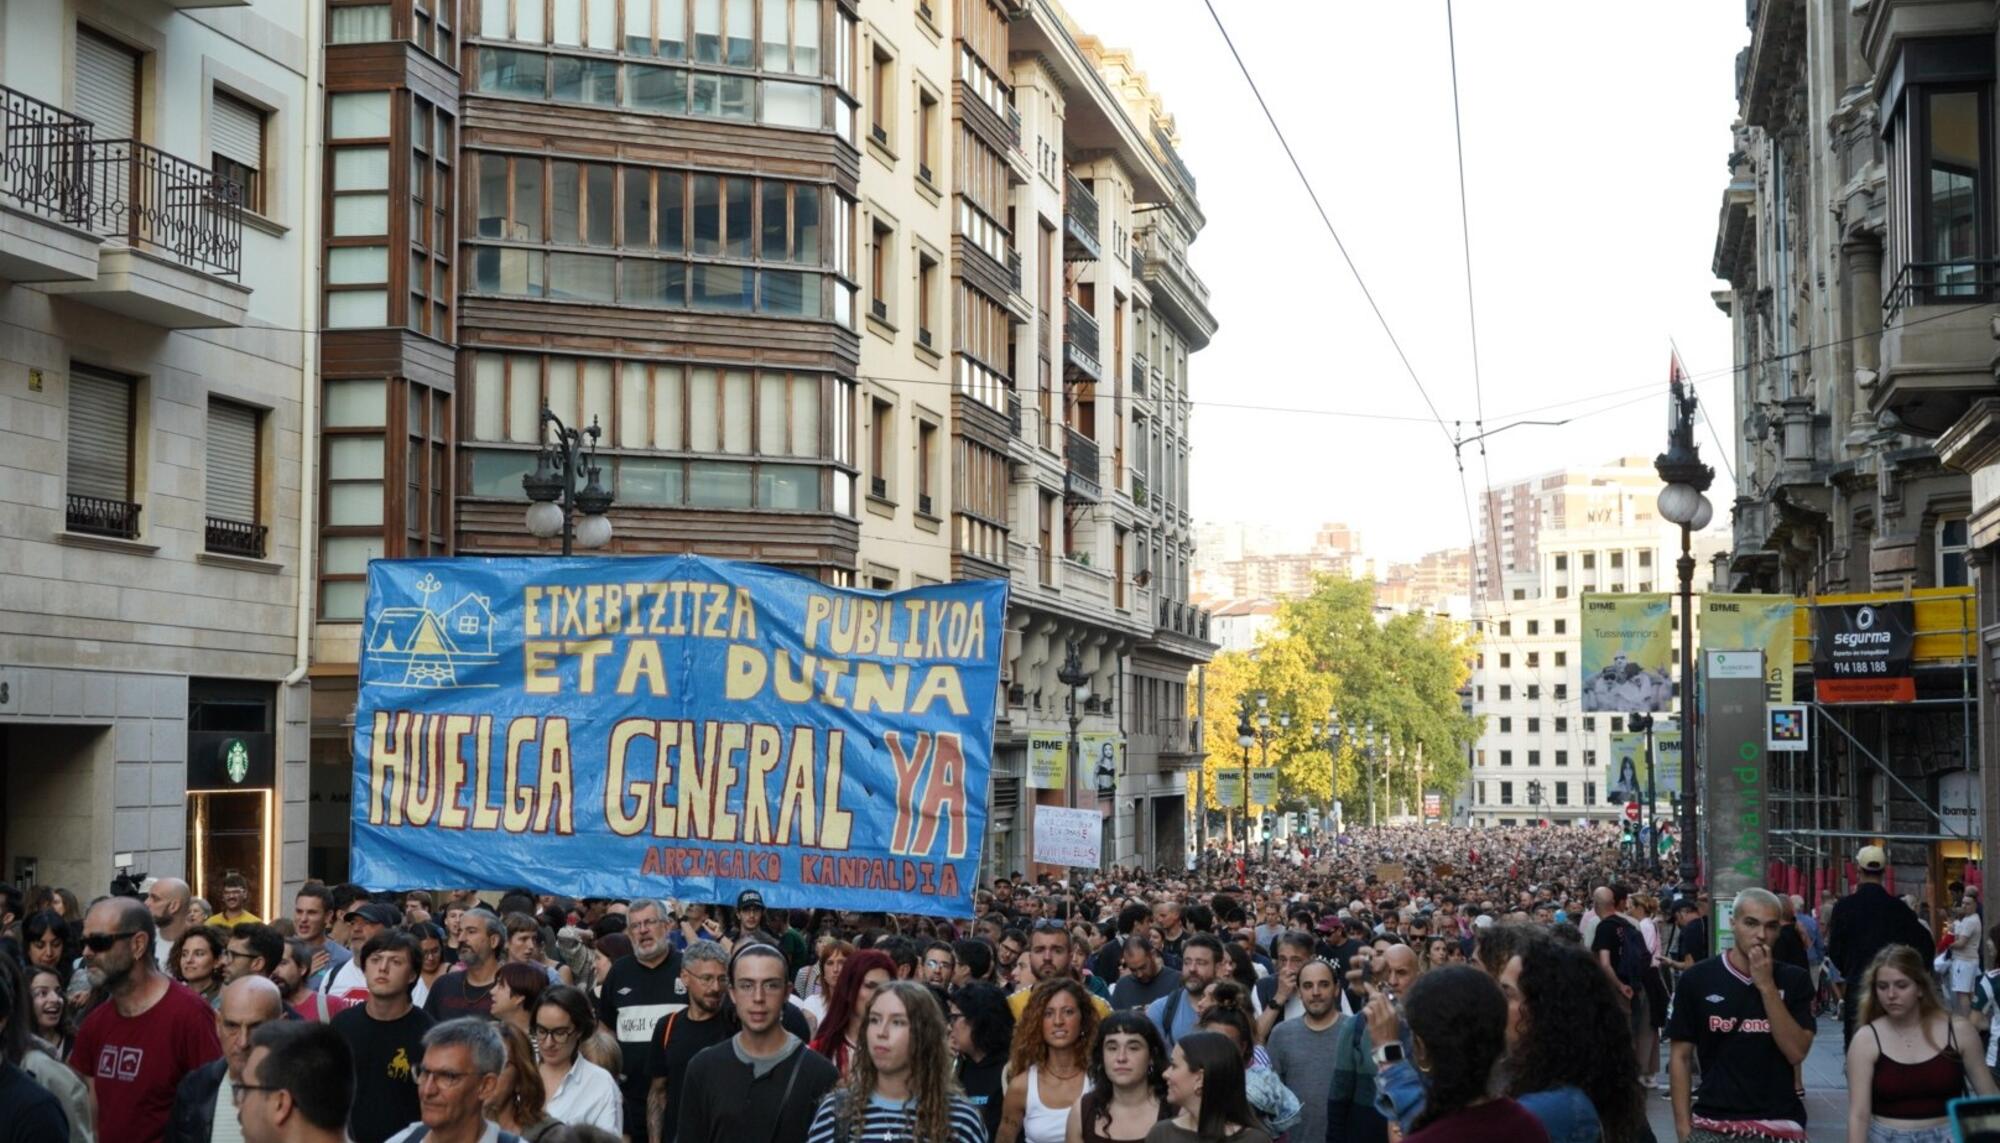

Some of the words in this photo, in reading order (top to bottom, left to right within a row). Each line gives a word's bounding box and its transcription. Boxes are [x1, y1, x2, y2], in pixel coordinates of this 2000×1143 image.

[524, 581, 757, 640] ETXEBIZITZA
[803, 594, 985, 659] PUBLIKOA
[1710, 603, 1739, 612] BIME
[1834, 632, 1891, 648] segurma
[524, 639, 669, 697] ETA
[725, 643, 970, 715] DUINA
[1834, 662, 1850, 673] 914
[1852, 662, 1868, 673] 188
[1870, 661, 1887, 673] 188
[1033, 740, 1062, 751] BIME
[369, 709, 575, 836] HUELGA
[604, 717, 853, 851] GENERAL
[883, 730, 967, 859] YA
[1732, 741, 1761, 879] Abando
[1942, 805, 1976, 816] Ibarrea
[640, 847, 781, 882] ARRIAGAKO
[802, 854, 960, 897] KANPALDIA
